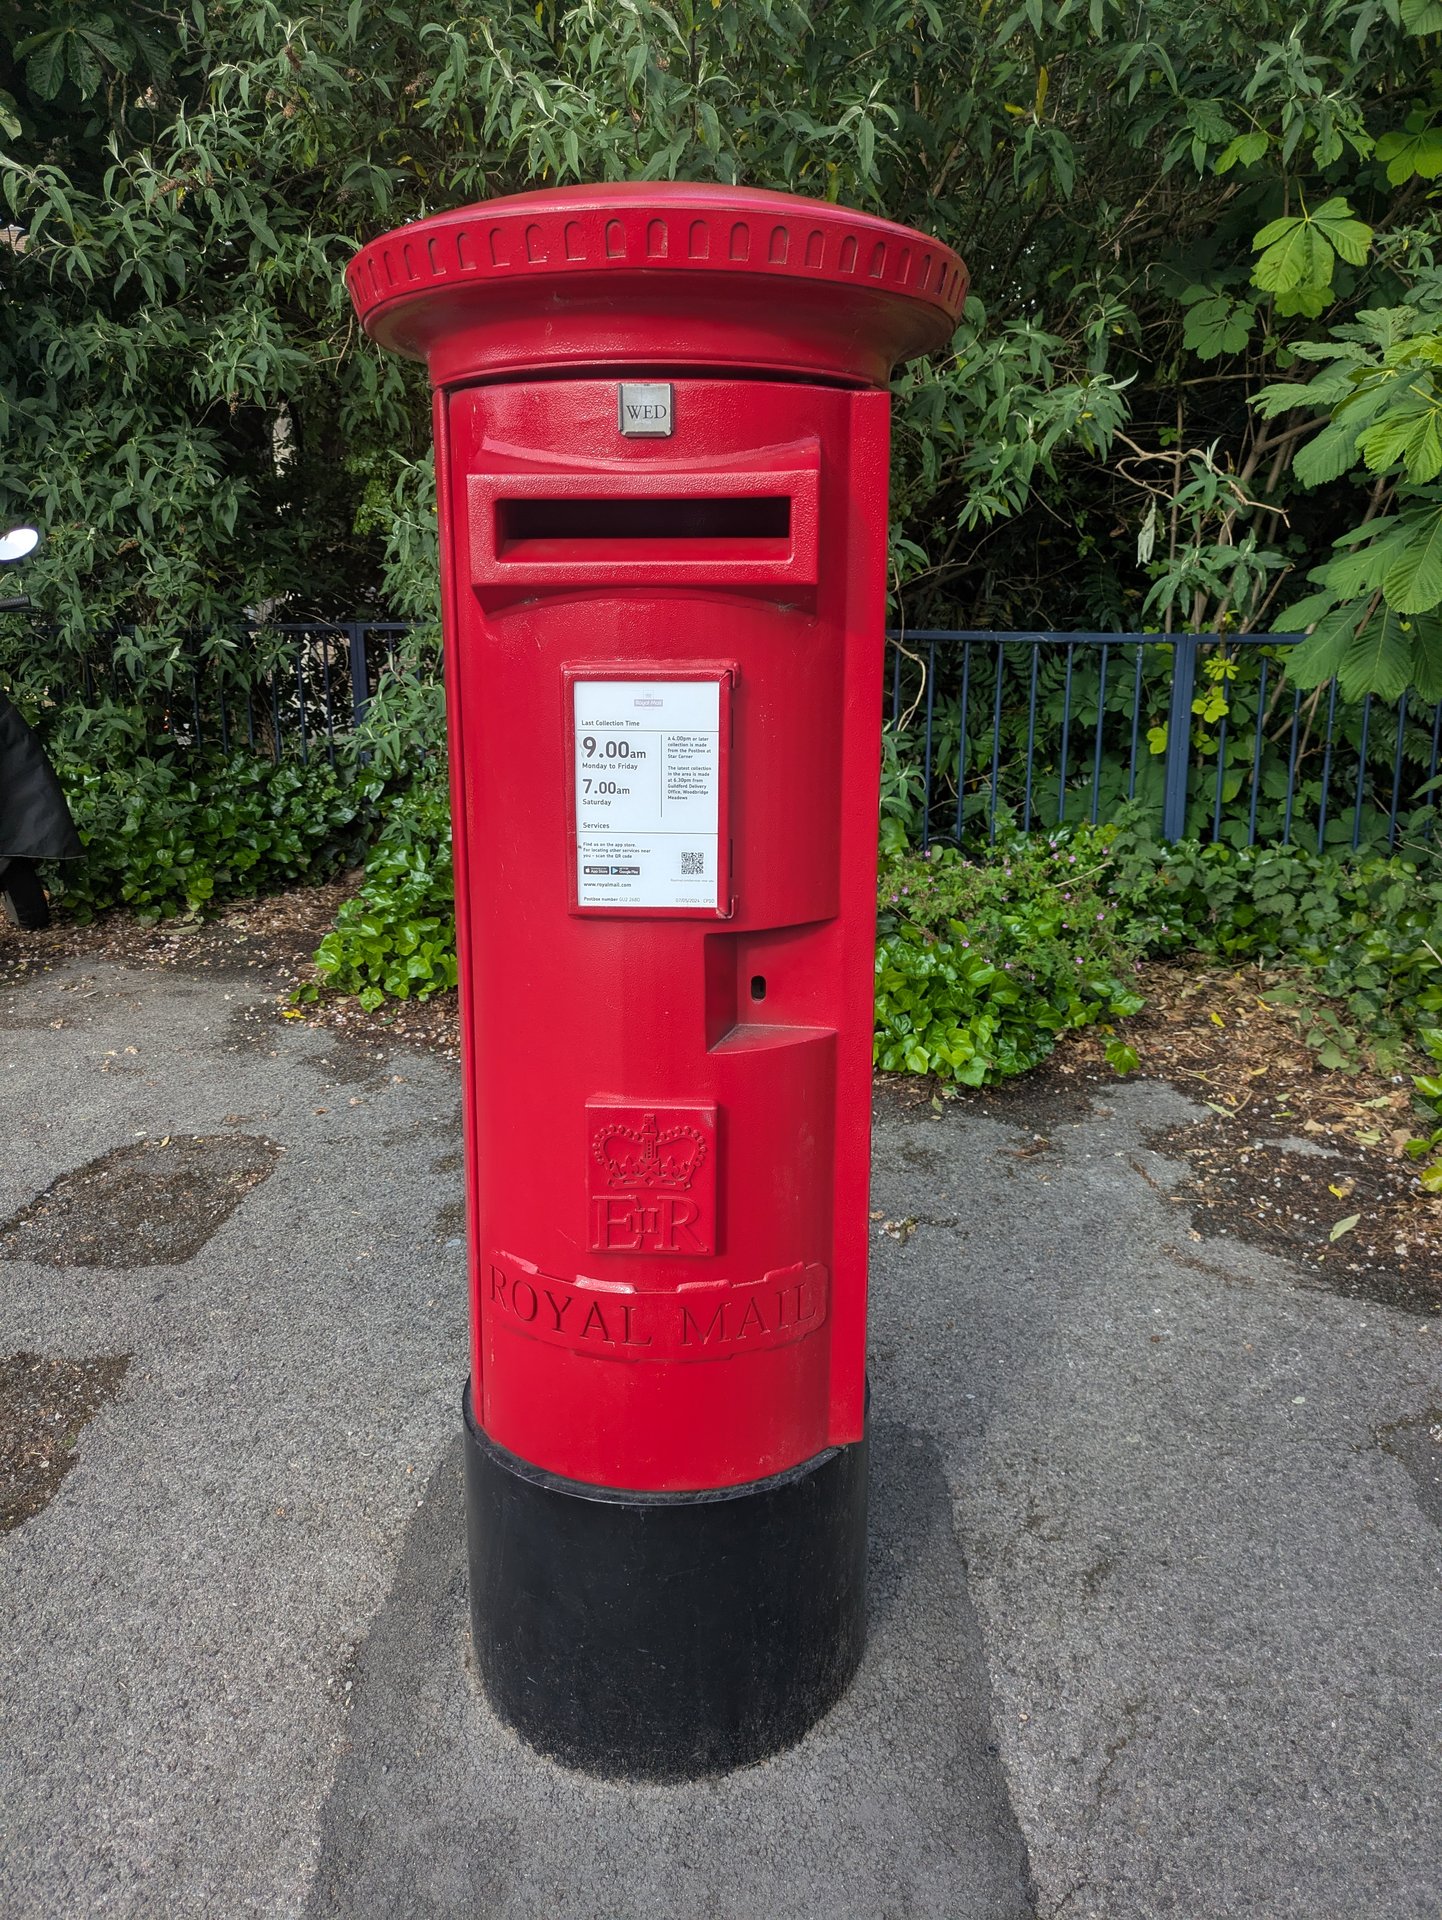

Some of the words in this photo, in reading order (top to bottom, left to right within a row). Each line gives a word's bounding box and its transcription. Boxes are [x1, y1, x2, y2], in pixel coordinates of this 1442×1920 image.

[626, 405, 667, 420] WED
[582, 736, 646, 758] 9.00am
[582, 762, 607, 770] Monday
[618, 763, 638, 771] Friday
[582, 779, 630, 794] 7.00am
[488, 1264, 652, 1346] ROYAL
[680, 1282, 817, 1346] MAIL
